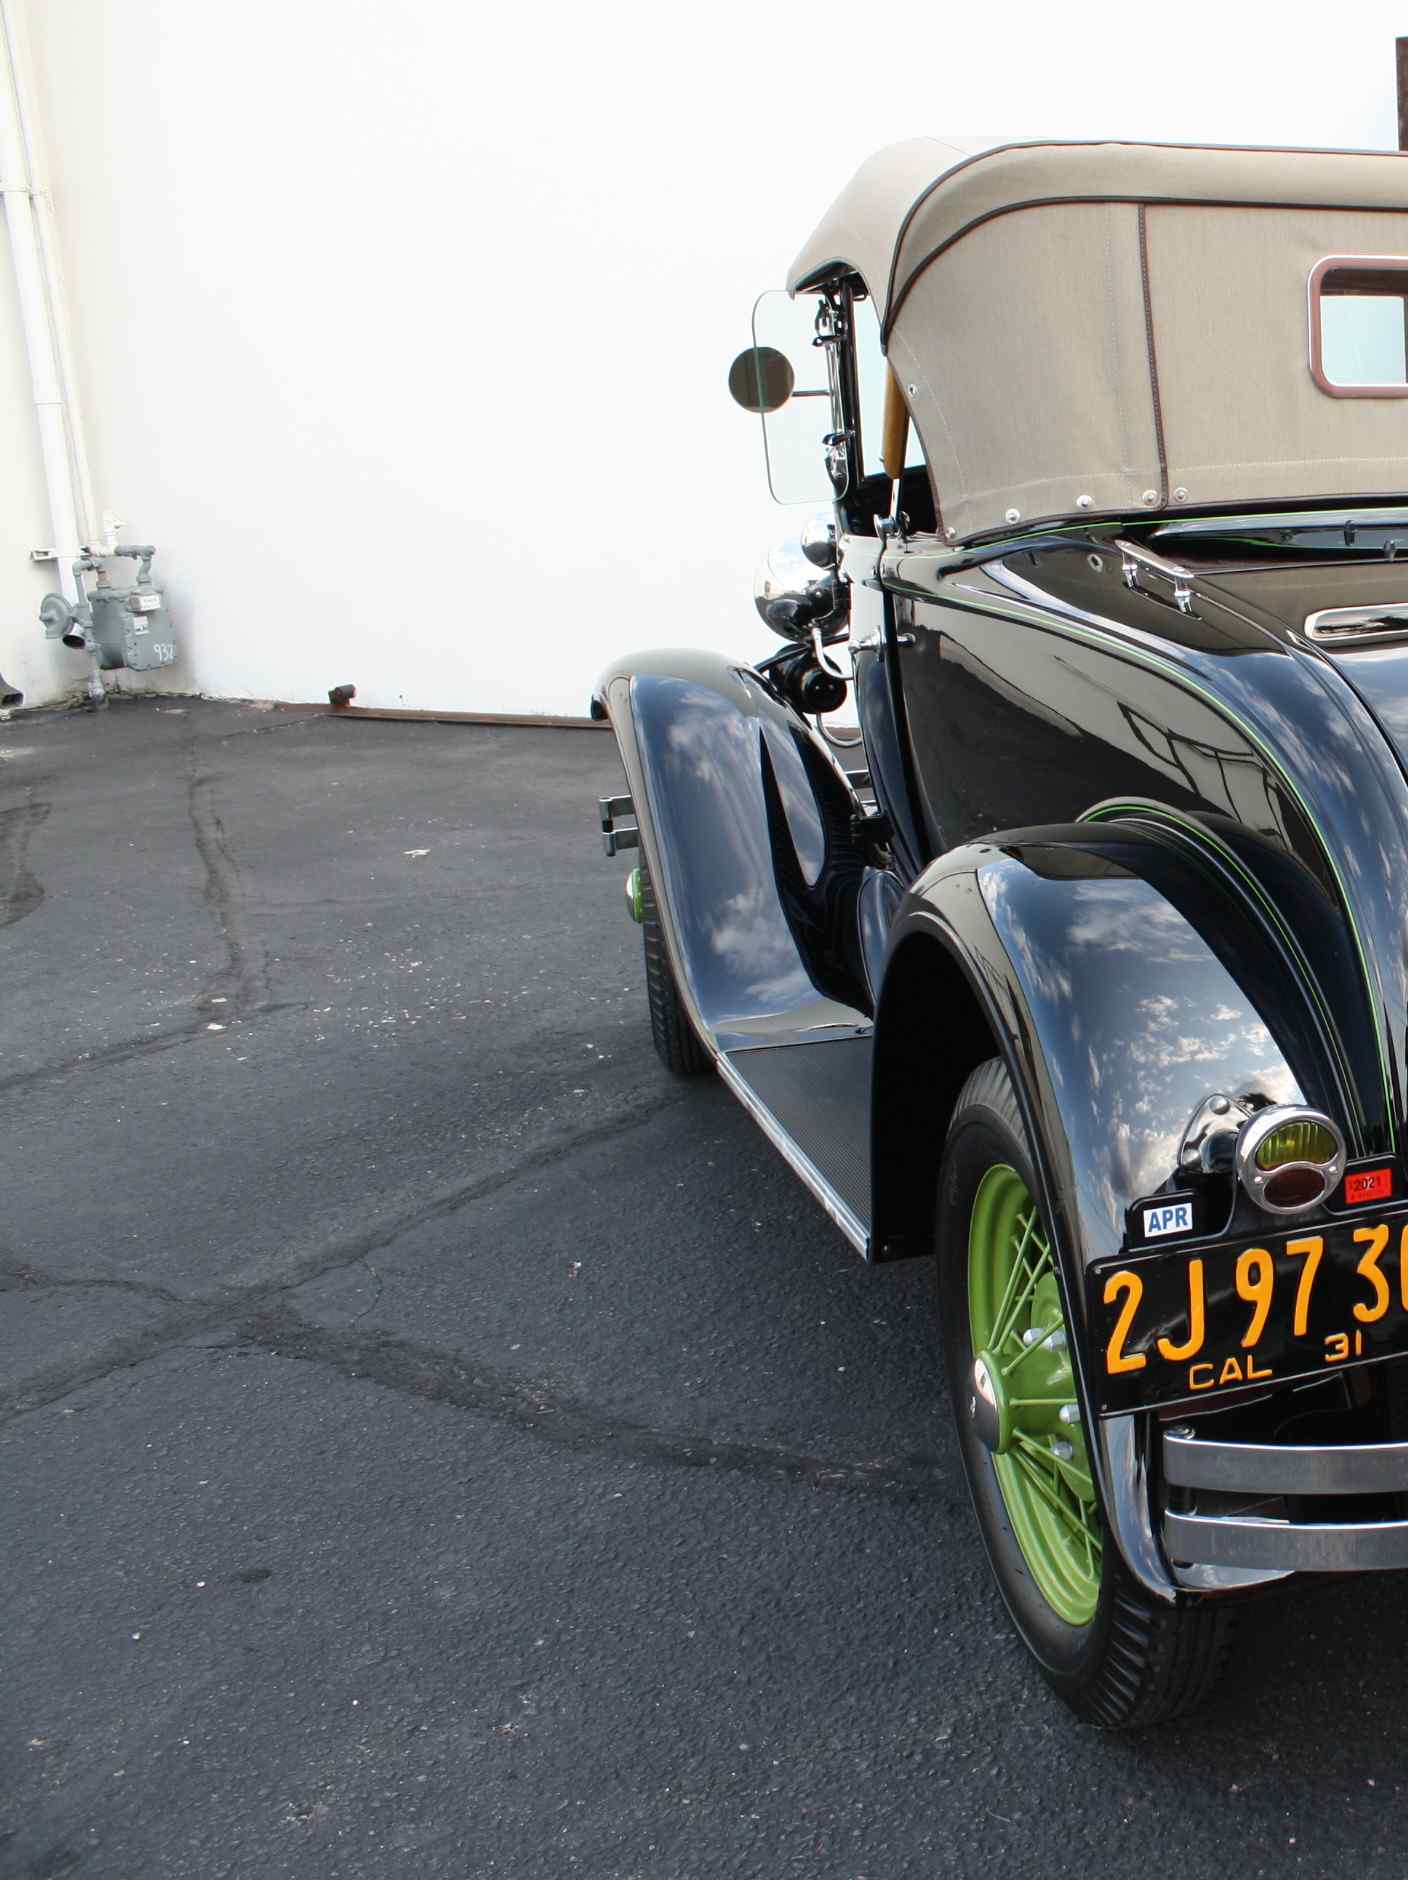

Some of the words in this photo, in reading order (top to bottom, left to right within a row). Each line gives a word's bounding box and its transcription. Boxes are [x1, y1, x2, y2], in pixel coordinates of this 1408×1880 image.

[1353, 1175, 1381, 1192] 2021
[1147, 1206, 1190, 1233] APR
[1188, 1354, 1273, 1391] CAL
[1323, 1329, 1363, 1363] 31
